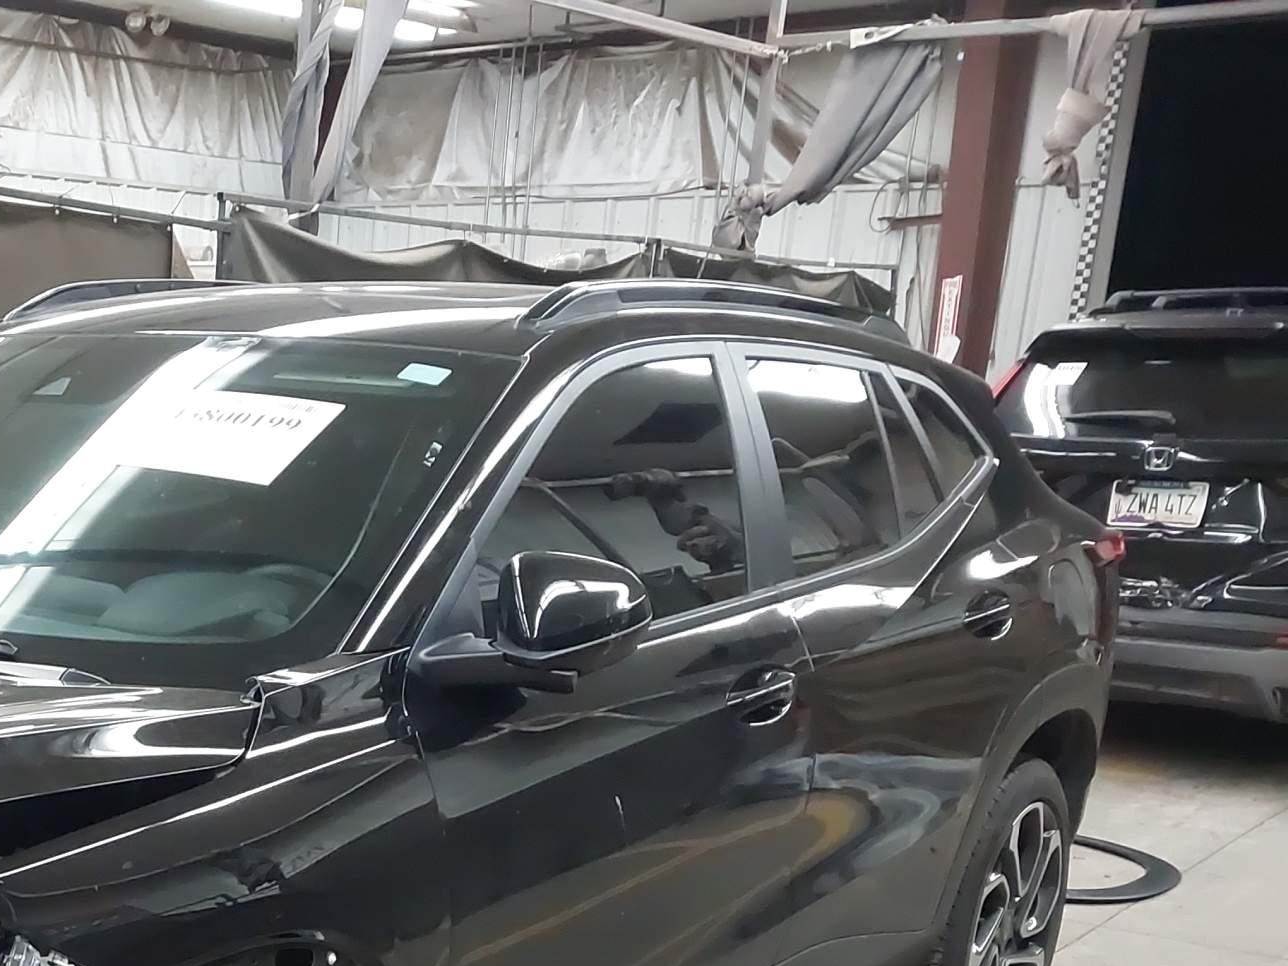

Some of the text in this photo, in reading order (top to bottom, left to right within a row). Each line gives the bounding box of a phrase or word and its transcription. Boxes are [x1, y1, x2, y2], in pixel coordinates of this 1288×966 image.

[174, 408, 303, 429] 800199
[1126, 492, 1198, 516] ZWA 4TZ
